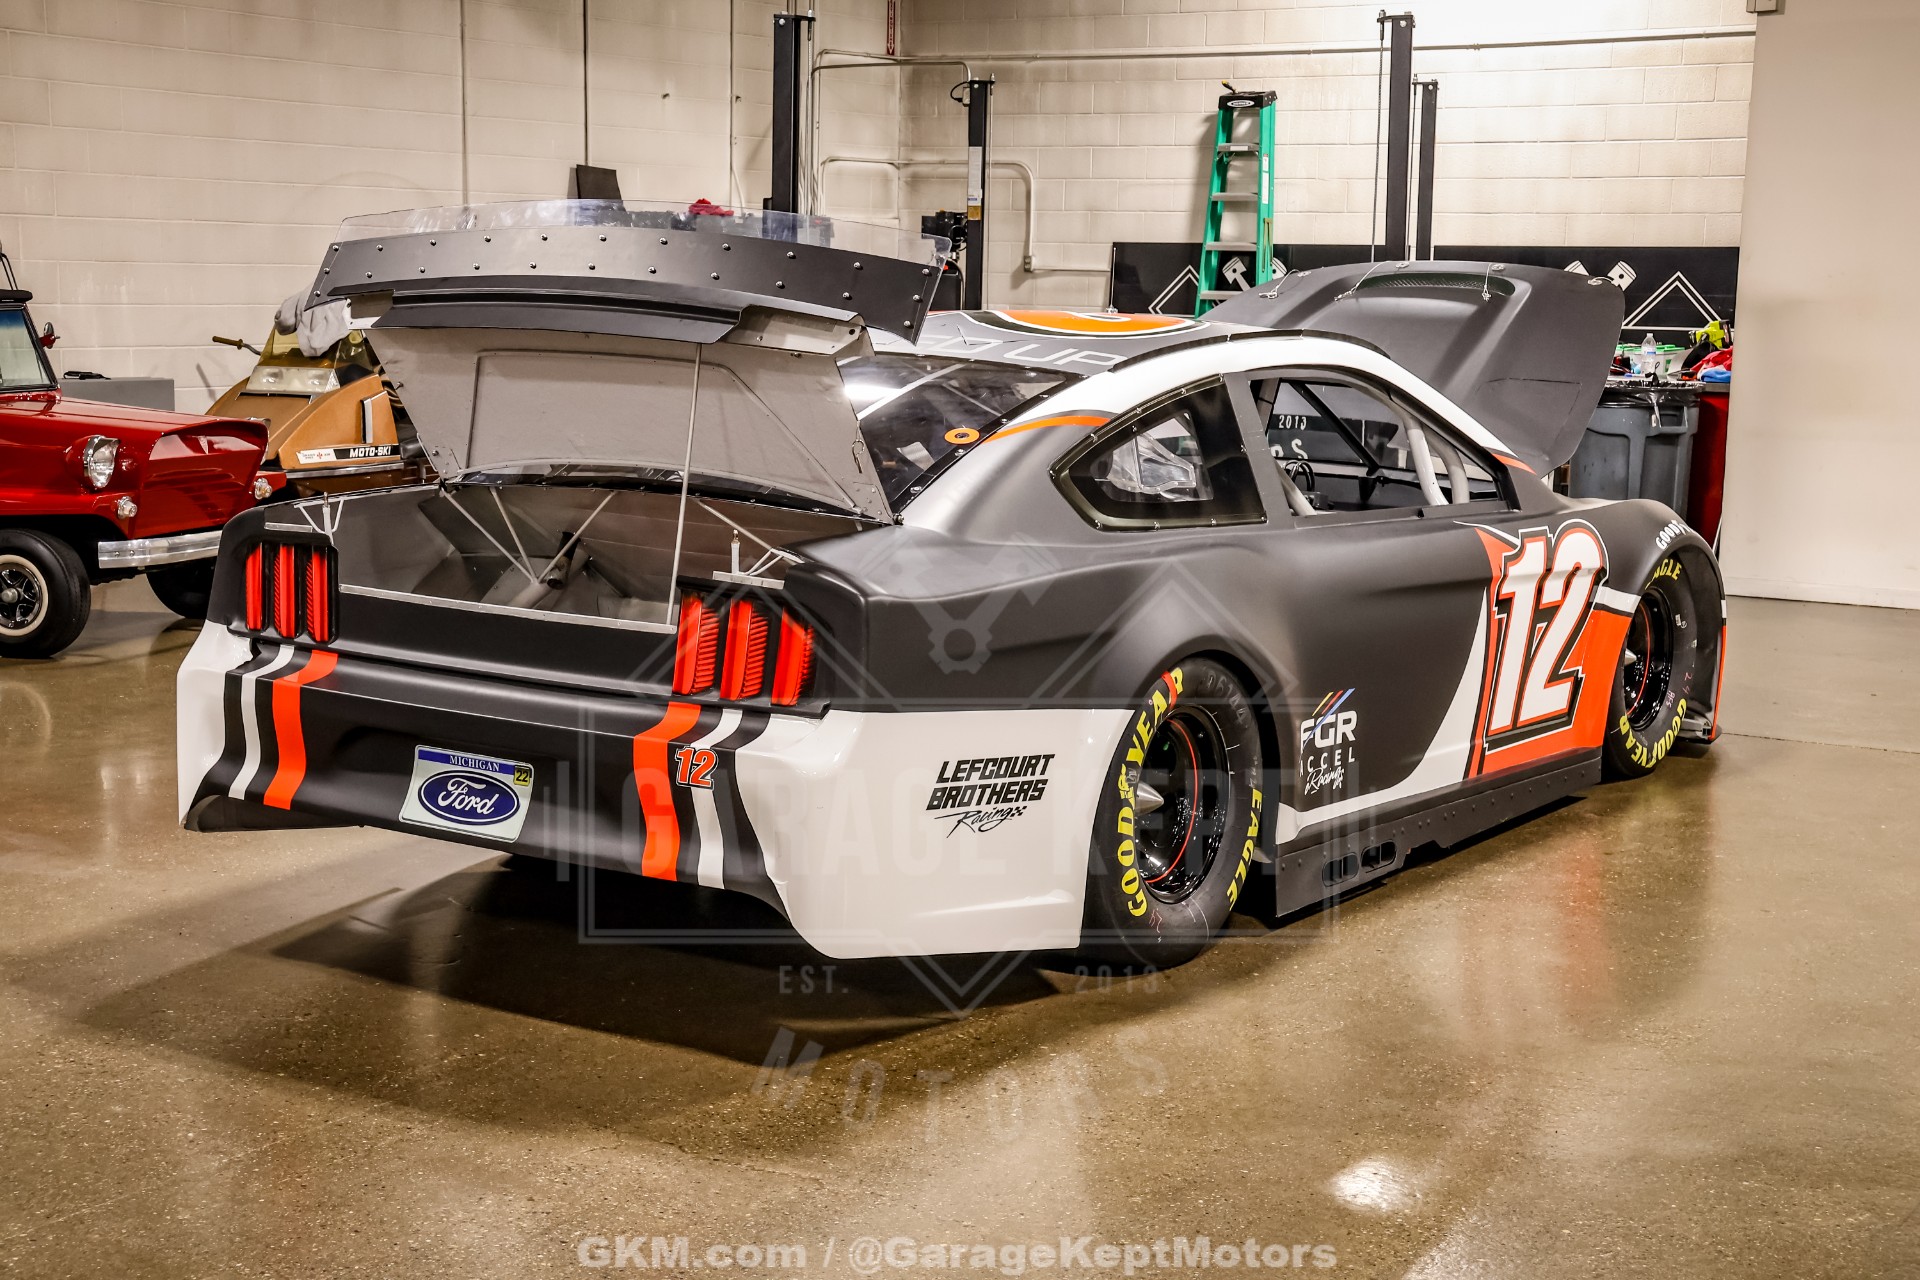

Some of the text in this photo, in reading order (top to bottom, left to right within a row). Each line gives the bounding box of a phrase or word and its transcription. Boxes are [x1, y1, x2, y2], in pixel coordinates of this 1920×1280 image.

[1003, 344, 1127, 365] UP
[1278, 414, 1307, 430] 2013
[1486, 522, 1607, 746] 12
[1300, 710, 1358, 754] FGR
[1620, 698, 1687, 768] GOODYEAR
[449, 755, 500, 772] MICHIGAN
[515, 769, 529, 783] 22
[675, 746, 718, 789] 12
[935, 753, 1055, 784] LEFCOURT
[437, 777, 500, 815] Ford
[926, 779, 1048, 810] BROTHERS
[934, 806, 1014, 838] Racing
[1227, 788, 1263, 911] EAGLE
